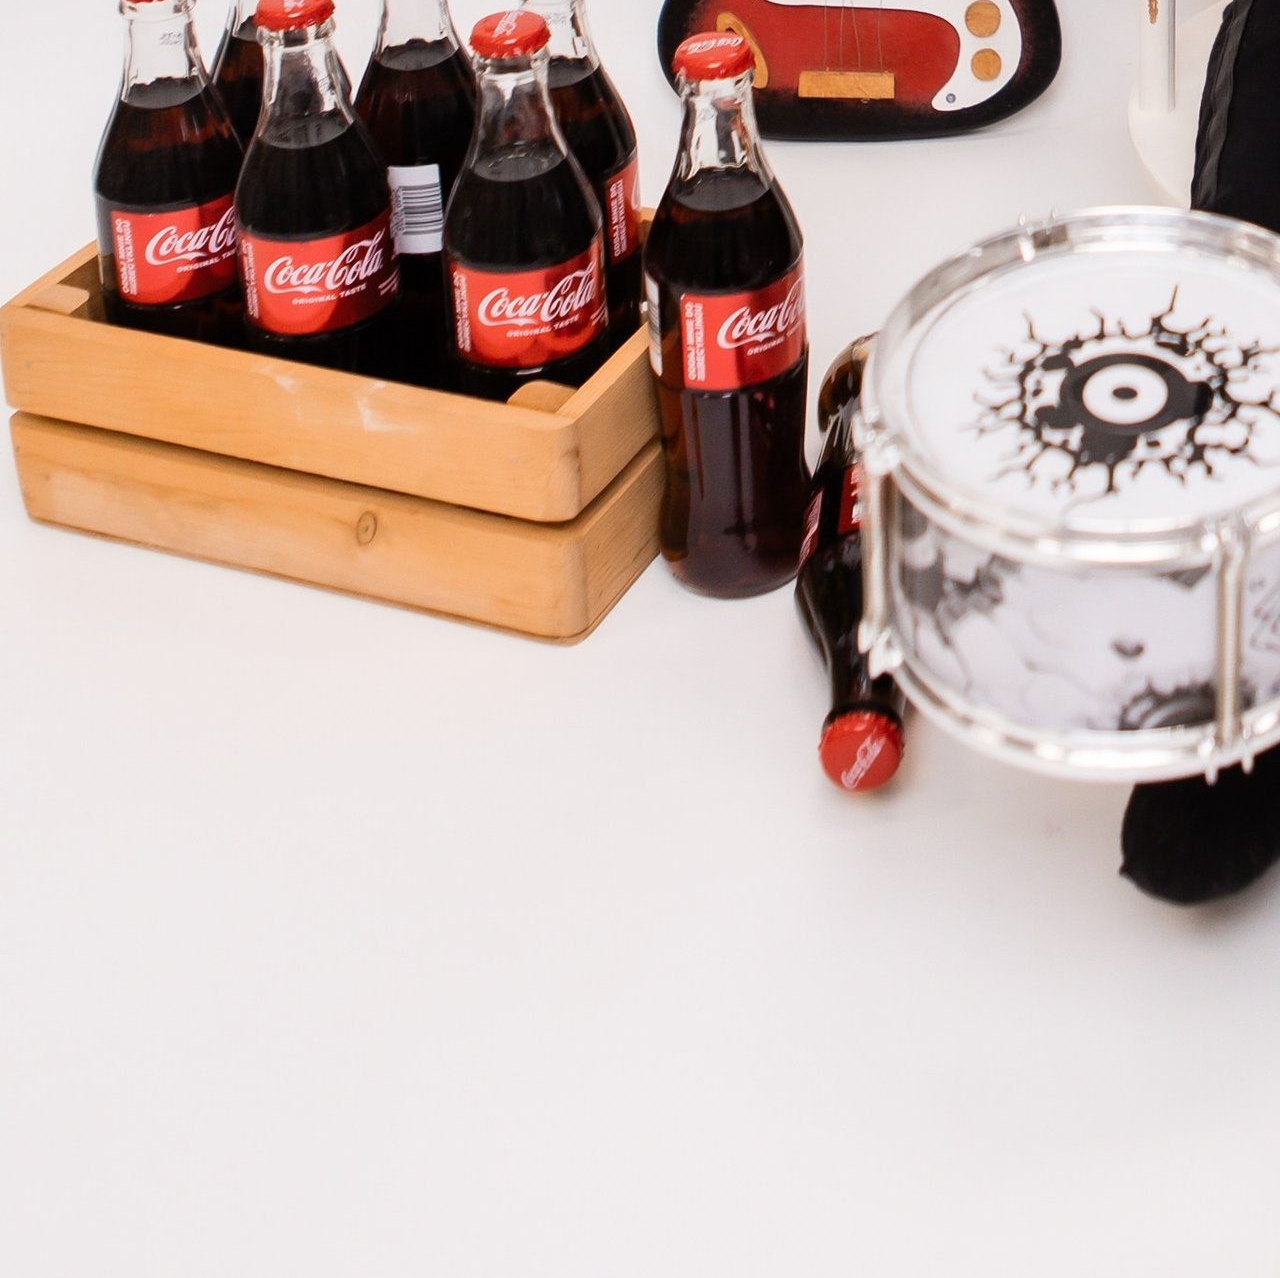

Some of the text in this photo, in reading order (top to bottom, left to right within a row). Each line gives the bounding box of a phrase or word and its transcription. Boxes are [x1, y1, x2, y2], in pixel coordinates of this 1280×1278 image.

[176, 257, 220, 273] ORIGINAL
[264, 227, 386, 294] Coca-Cola
[291, 283, 367, 306] ORIGINAL TASTE
[477, 257, 597, 326] Coca-Cola
[506, 314, 580, 338] ORIGINAL TASTE
